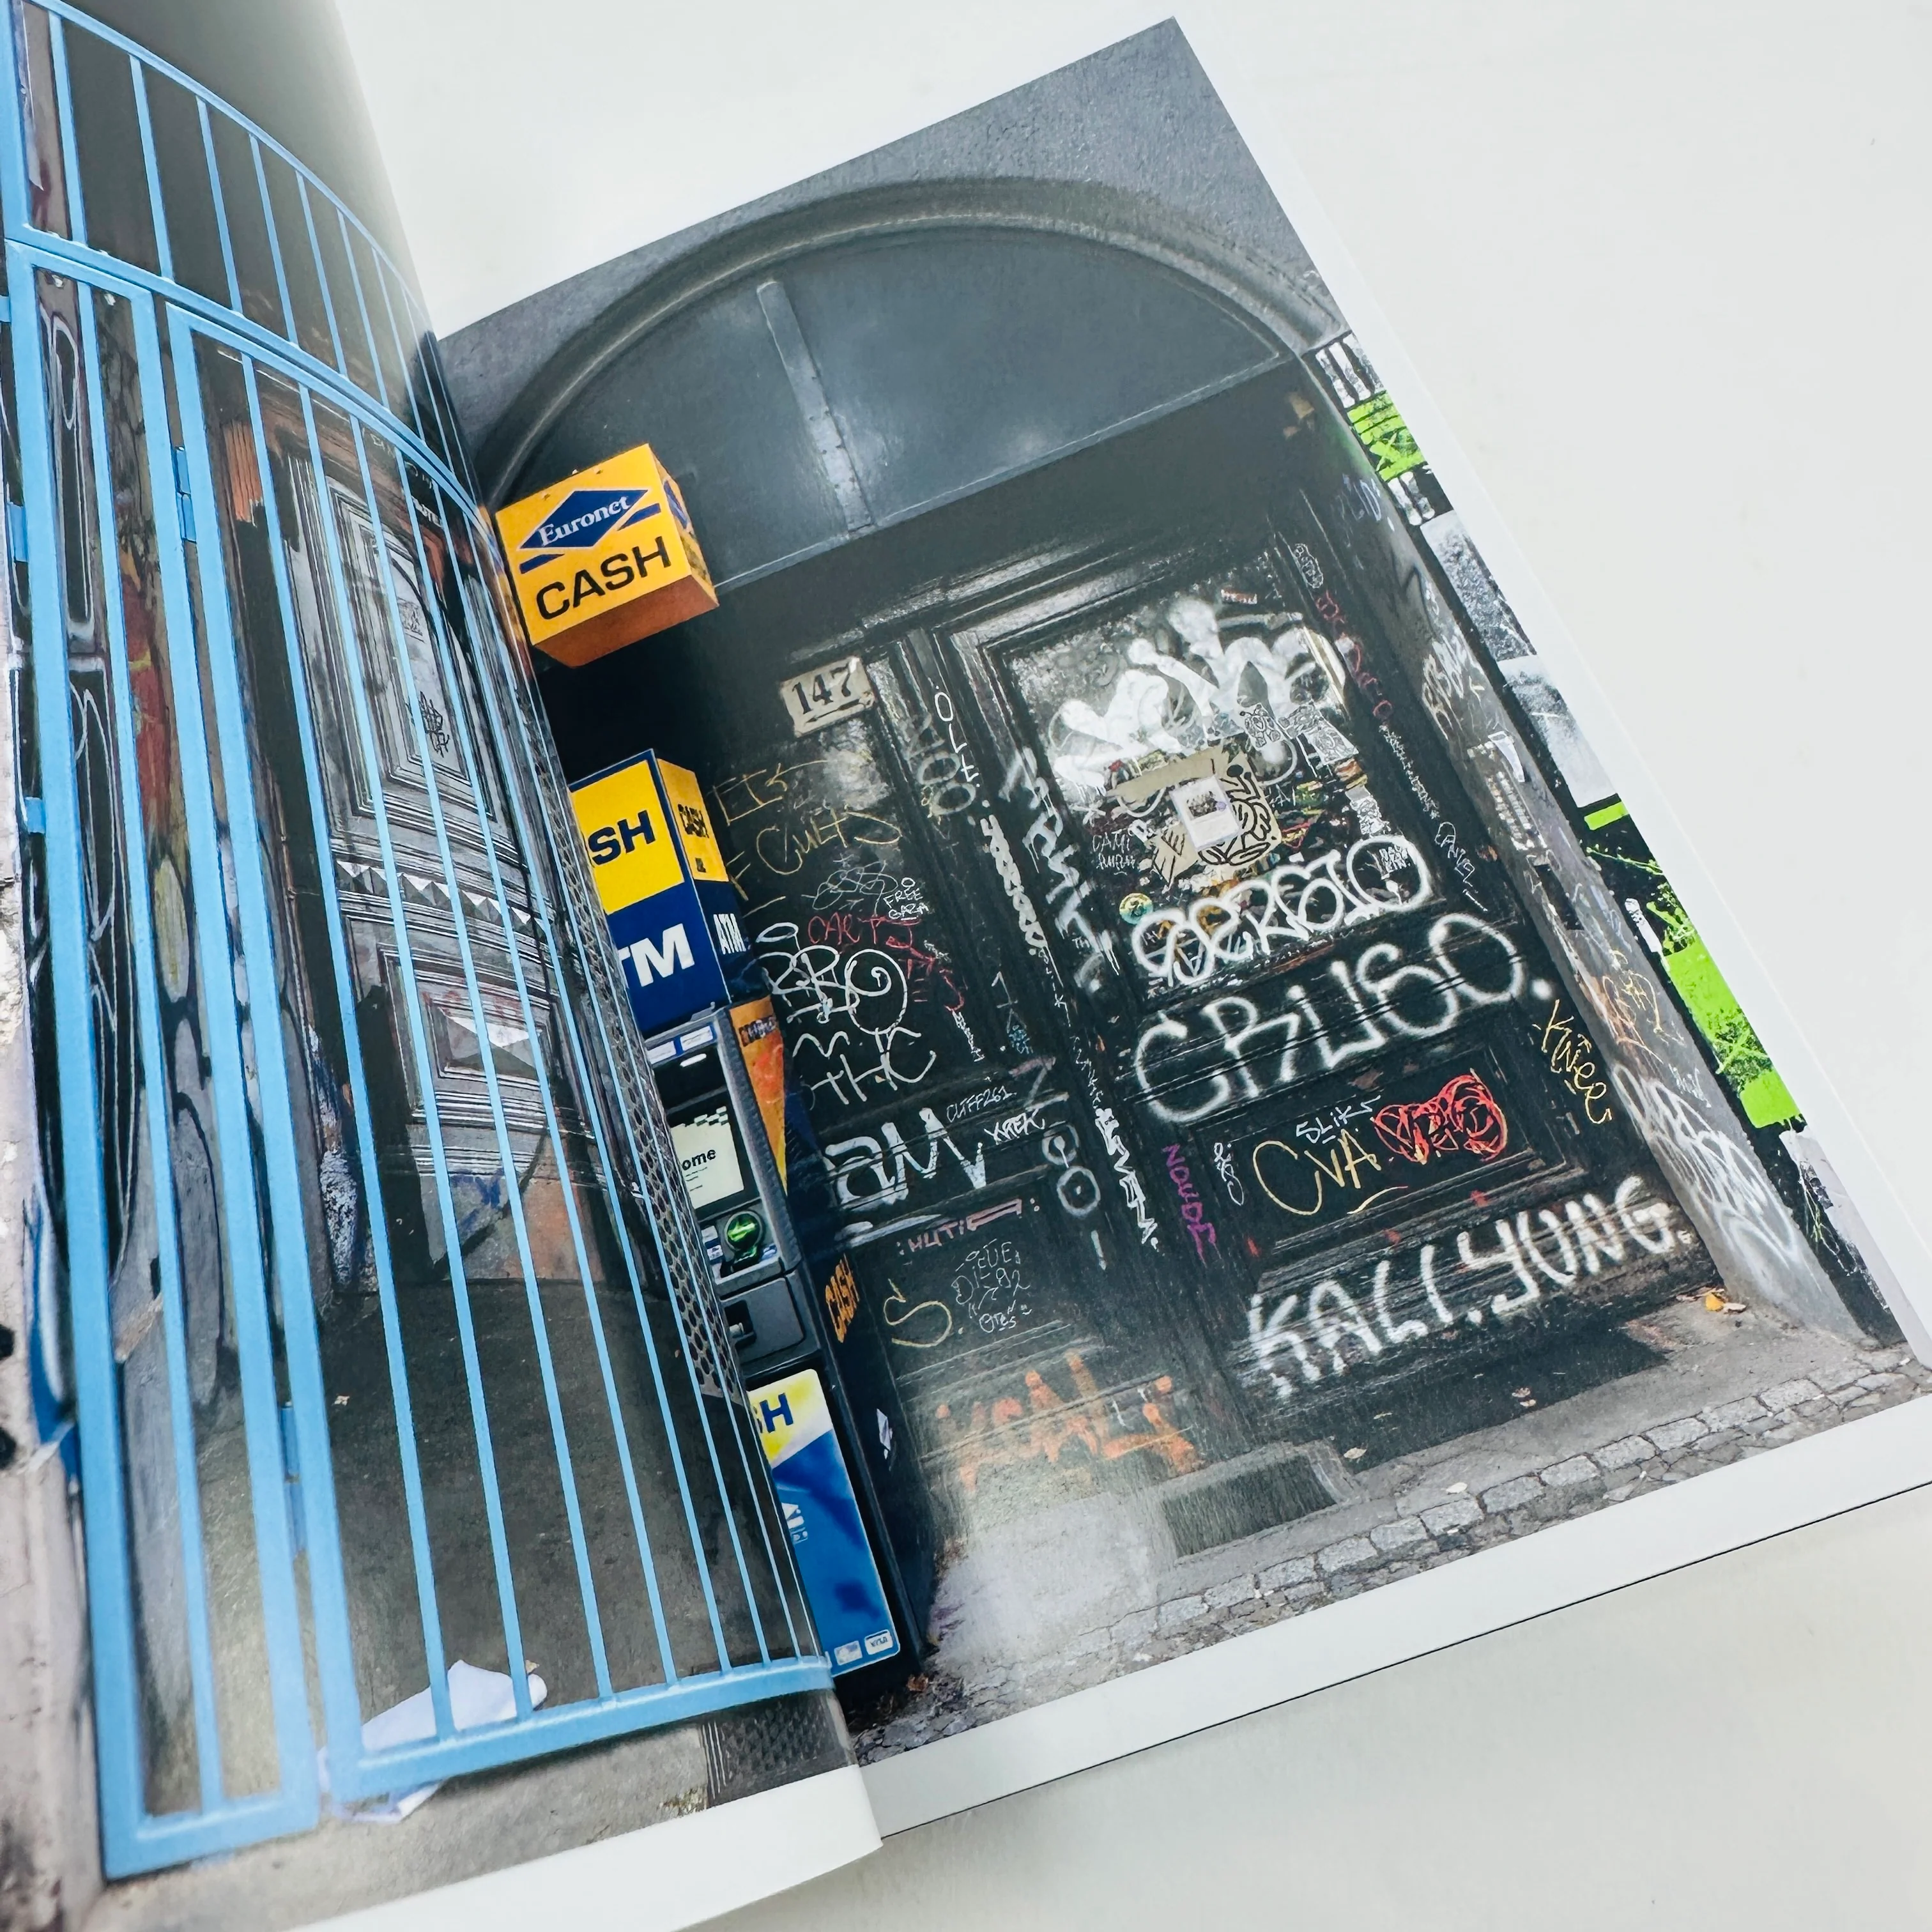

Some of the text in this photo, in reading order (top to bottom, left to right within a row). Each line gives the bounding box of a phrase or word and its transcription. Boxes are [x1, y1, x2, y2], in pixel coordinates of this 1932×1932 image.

[536, 493, 631, 548] Euronet
[535, 535, 671, 620] CASH
[792, 664, 852, 715] 147
[682, 1149, 716, 1170] ome
